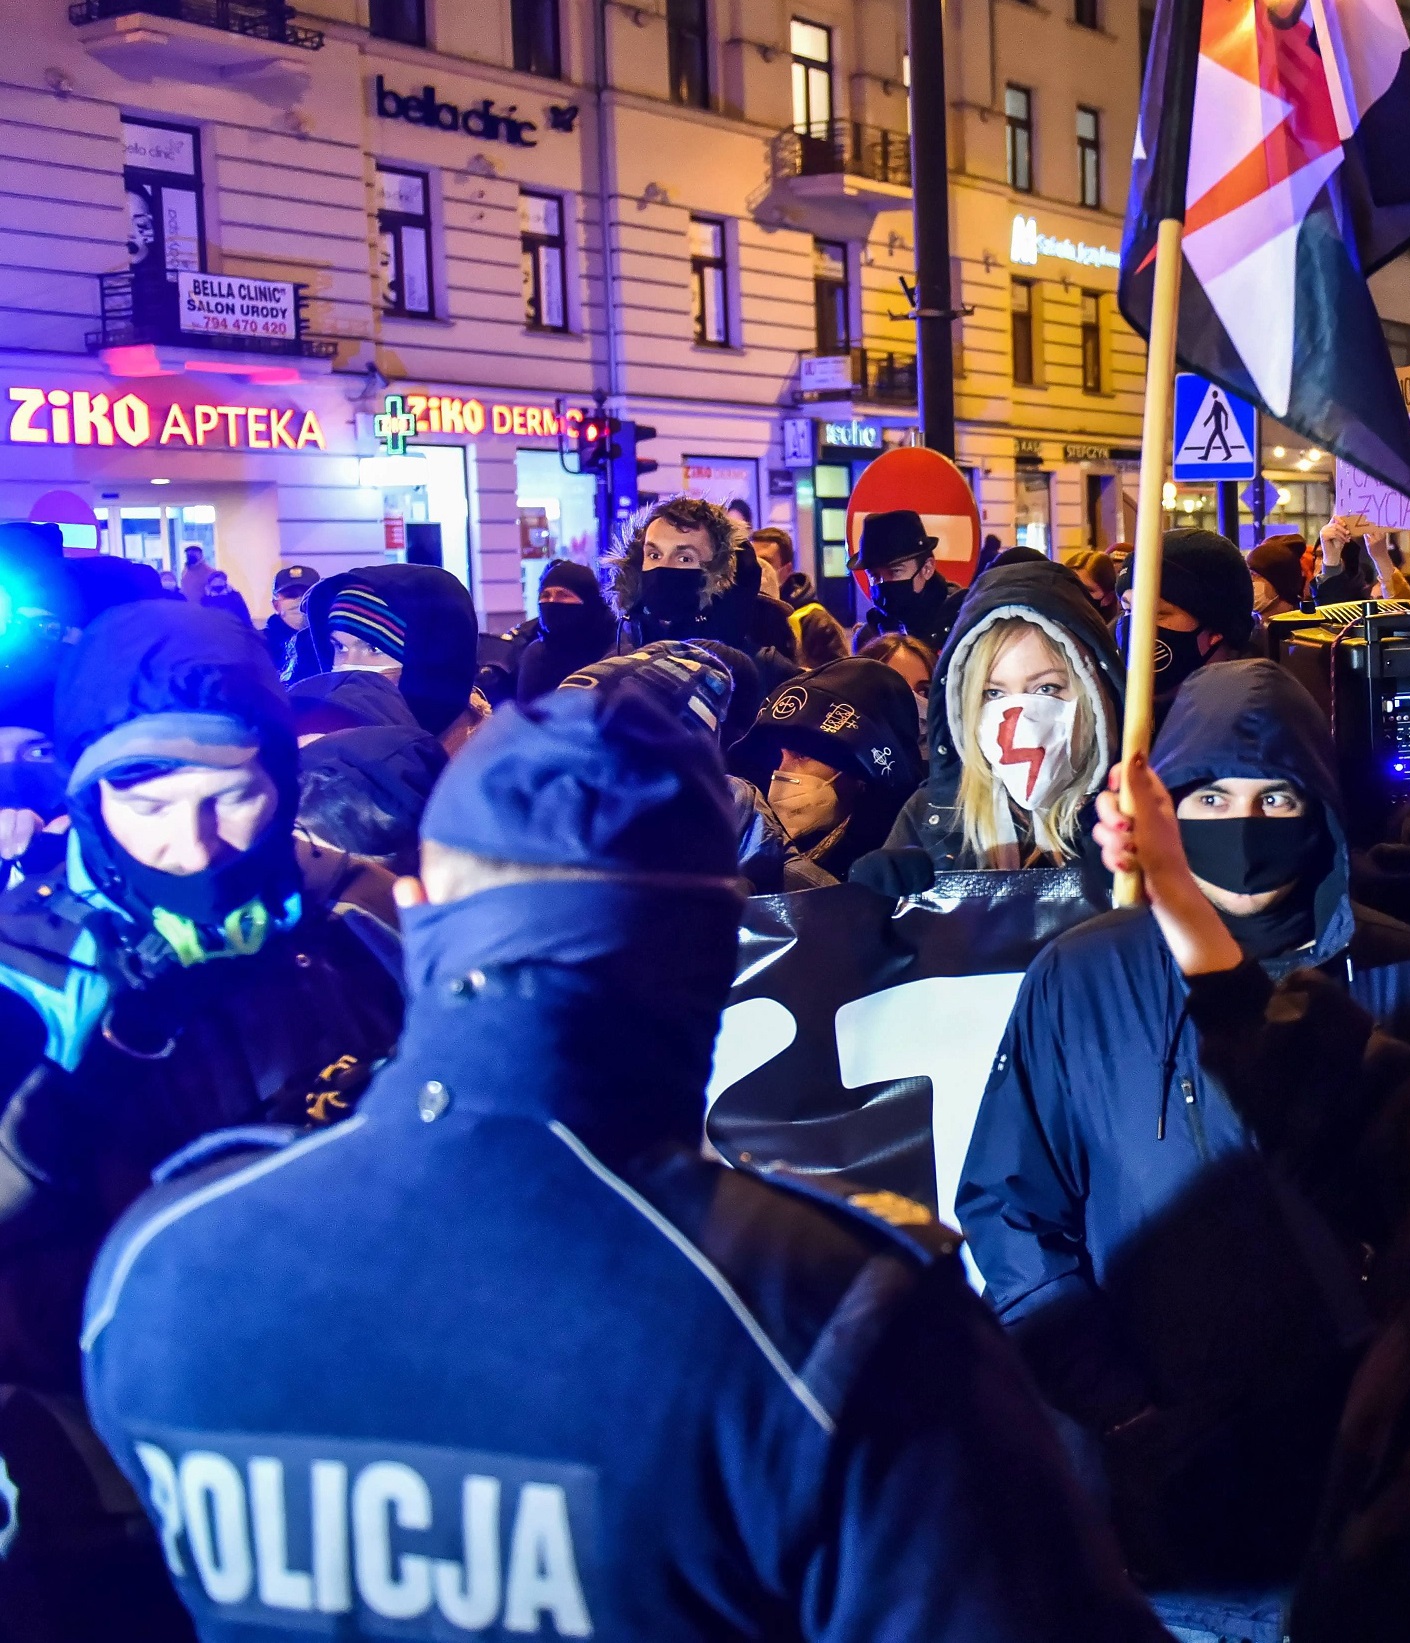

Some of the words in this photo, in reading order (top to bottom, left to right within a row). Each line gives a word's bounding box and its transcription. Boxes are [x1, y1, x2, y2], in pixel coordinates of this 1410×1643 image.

[375, 73, 459, 132] bella
[461, 99, 538, 148] clinic
[192, 279, 236, 299] BELLA
[186, 299, 236, 315] SALON
[240, 304, 288, 319] URODY
[203, 316, 228, 329] 794
[232, 319, 258, 333] 470
[262, 322, 287, 335] 420
[159, 402, 327, 451] APTEKA
[135, 1441, 594, 1638] POLICJA
